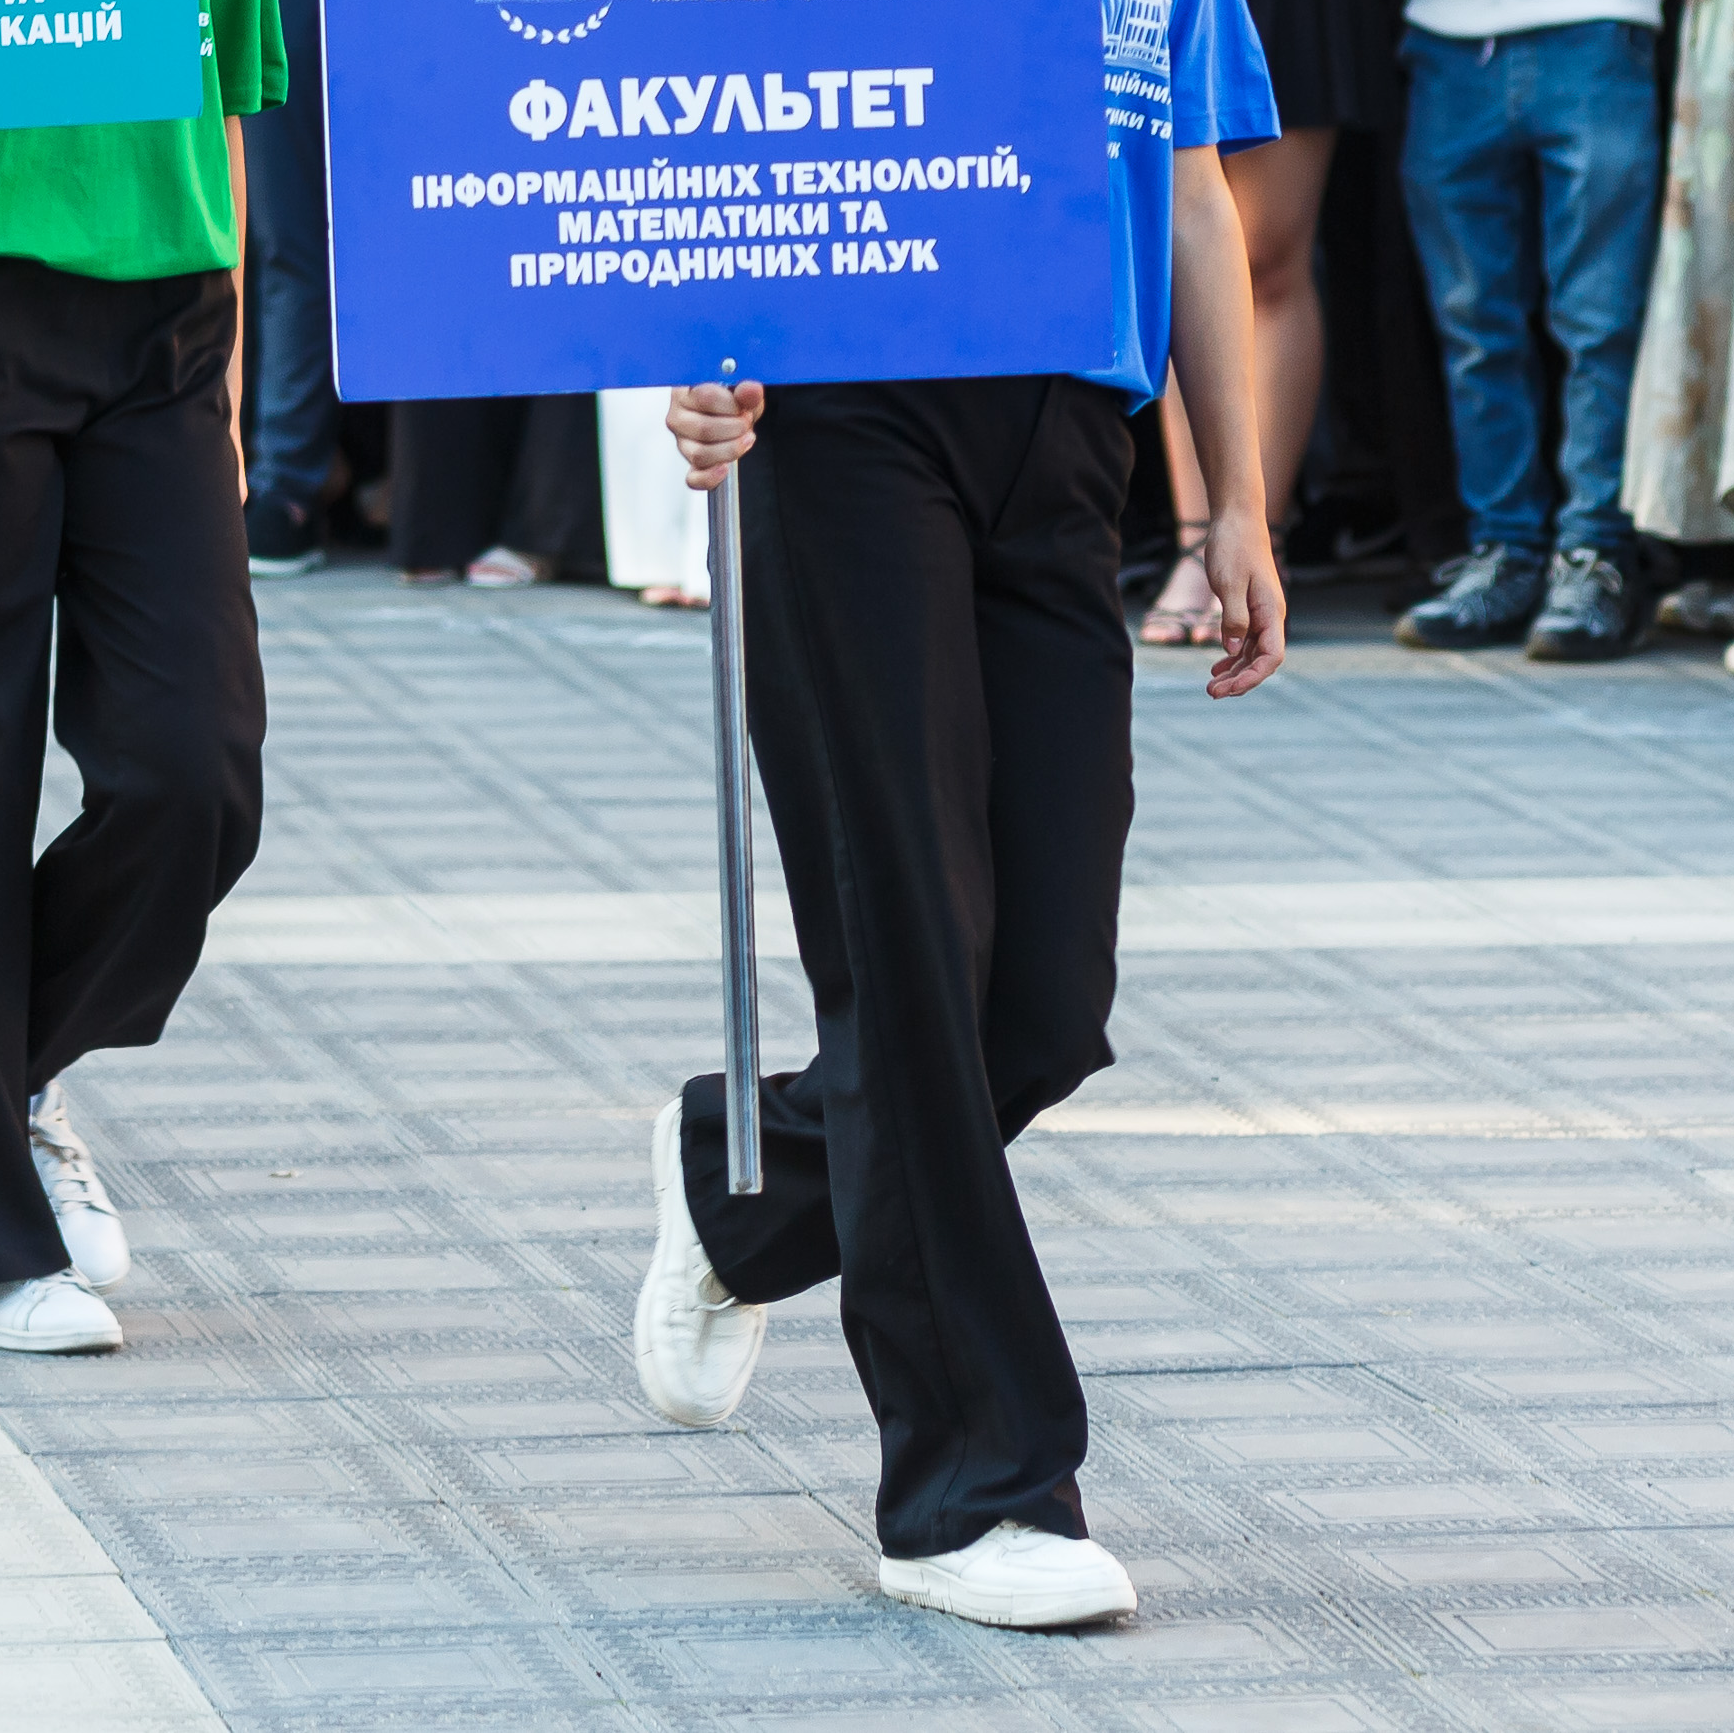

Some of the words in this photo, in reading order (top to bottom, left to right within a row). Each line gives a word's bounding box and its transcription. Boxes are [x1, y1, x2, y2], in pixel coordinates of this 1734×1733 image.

[509, 67, 934, 141] ФАКУЛЬТЕТ
[411, 158, 761, 210] ІНФОРМАЦІЙНИХ
[771, 145, 1033, 196] ТЕХНОЛОГІЙ,
[558, 203, 829, 244] МАТЕМАТИКИ
[839, 200, 888, 234] ТА
[509, 245, 821, 289] ПРИРОДНИЧИХ
[831, 238, 940, 274] НАУК
